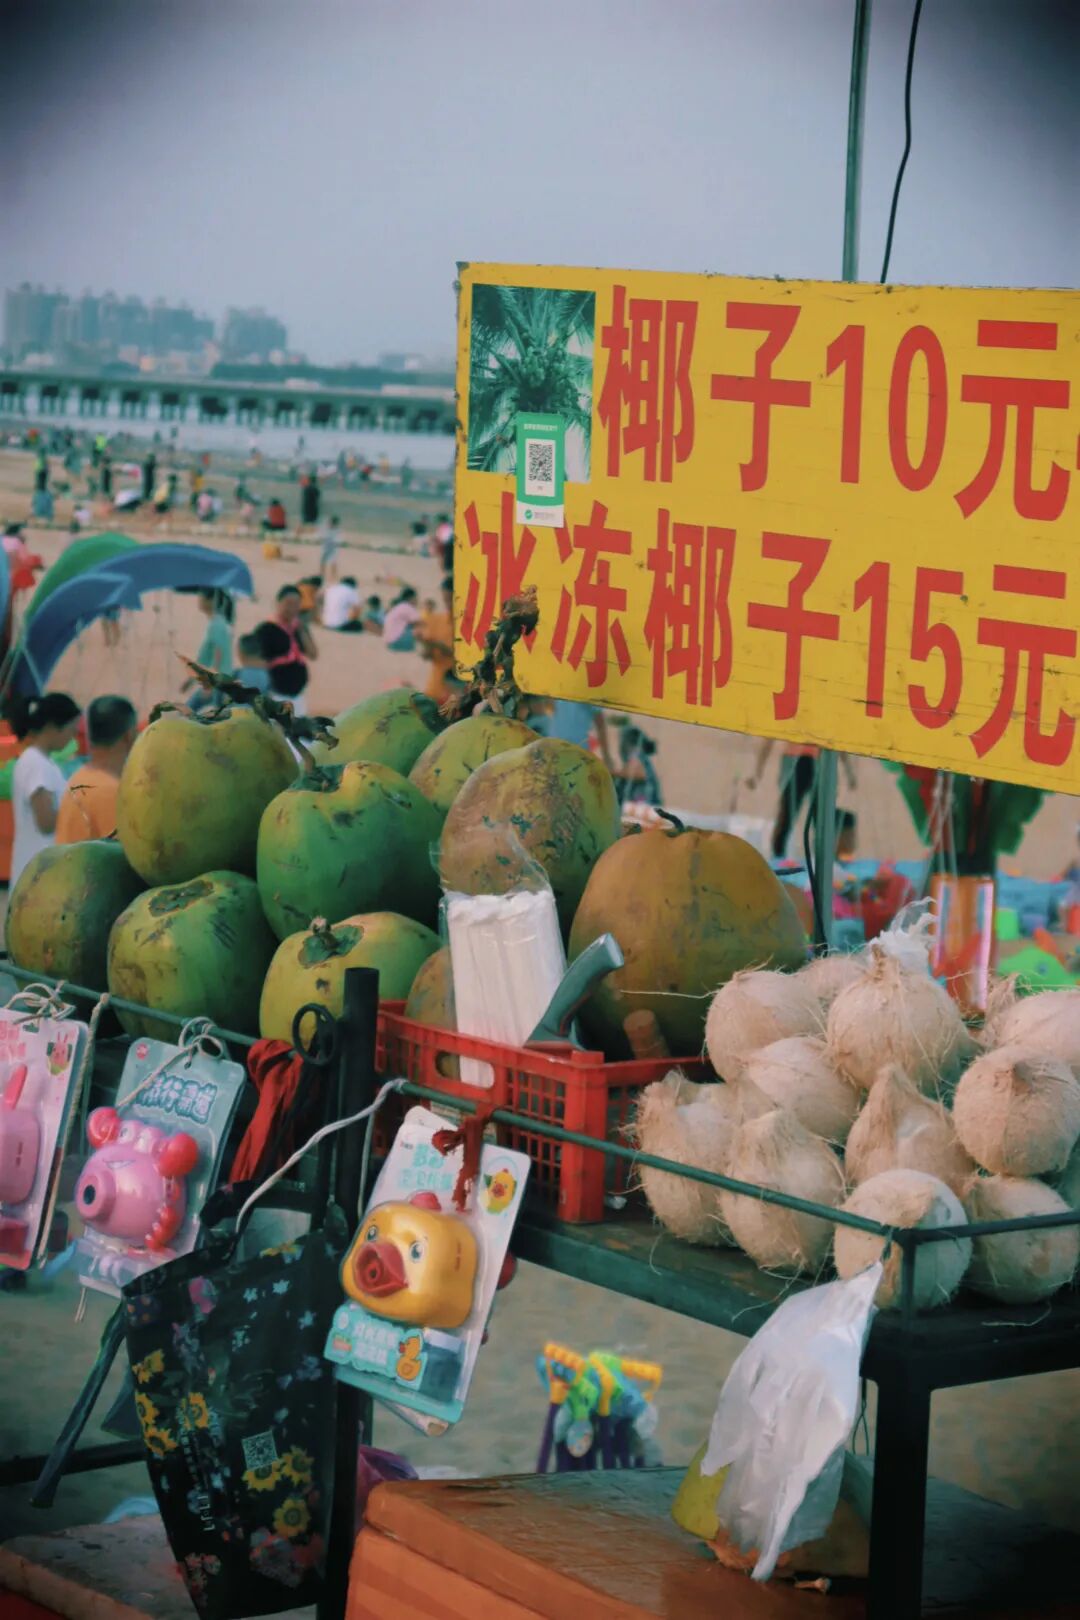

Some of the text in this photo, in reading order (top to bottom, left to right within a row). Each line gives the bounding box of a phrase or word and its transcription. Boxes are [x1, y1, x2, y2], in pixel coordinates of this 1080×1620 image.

[598, 284, 1080, 522] 椰子10元
[459, 491, 1077, 767] 冰冻椰子15元
